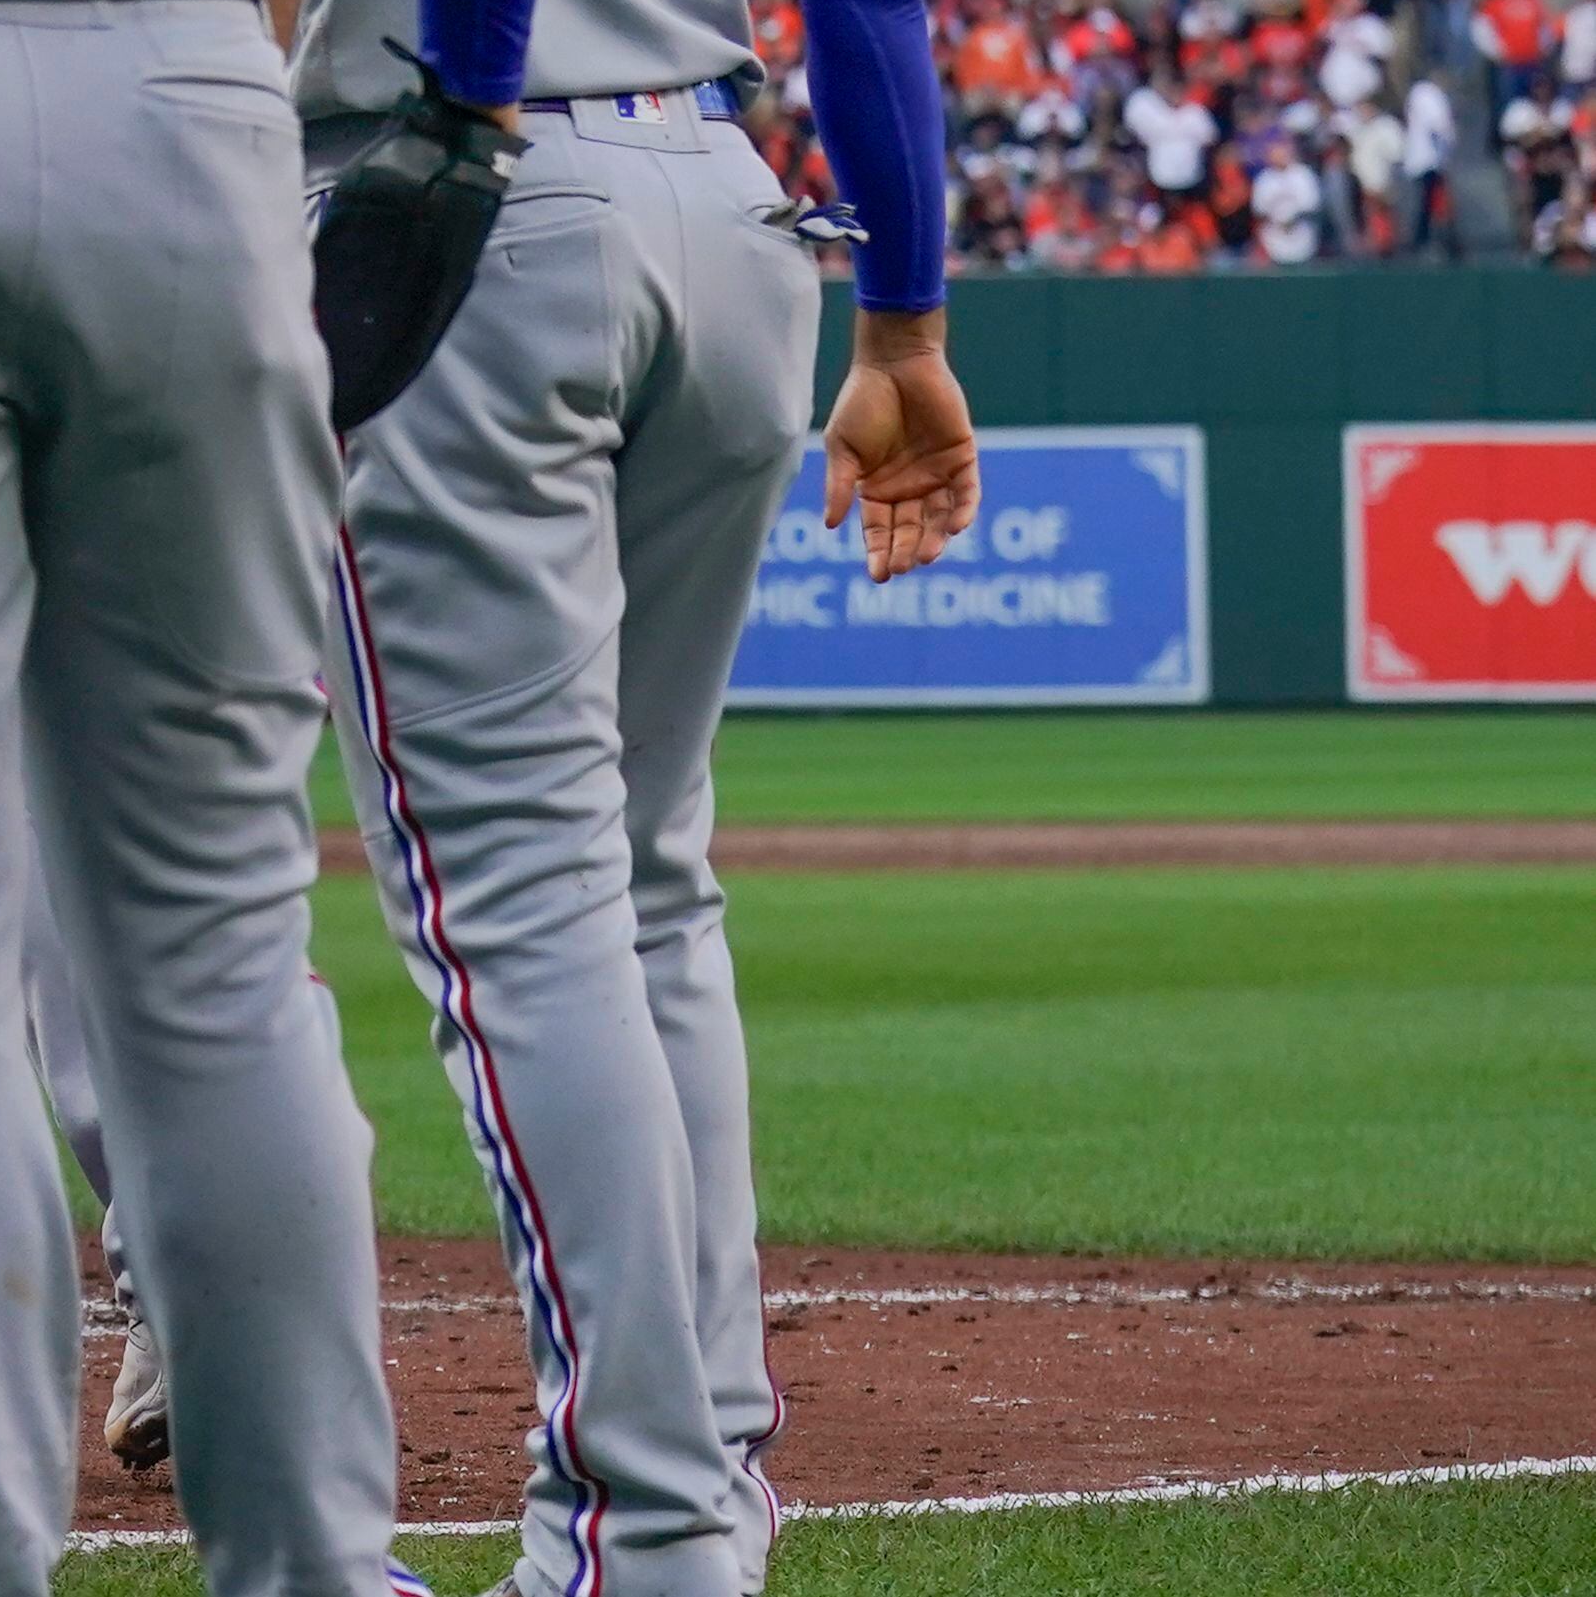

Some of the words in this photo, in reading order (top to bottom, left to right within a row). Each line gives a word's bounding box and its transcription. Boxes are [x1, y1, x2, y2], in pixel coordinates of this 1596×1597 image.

[991, 507, 1067, 562] OF
[1434, 518, 1596, 608] W
[847, 572, 1109, 627] MEDICINE
